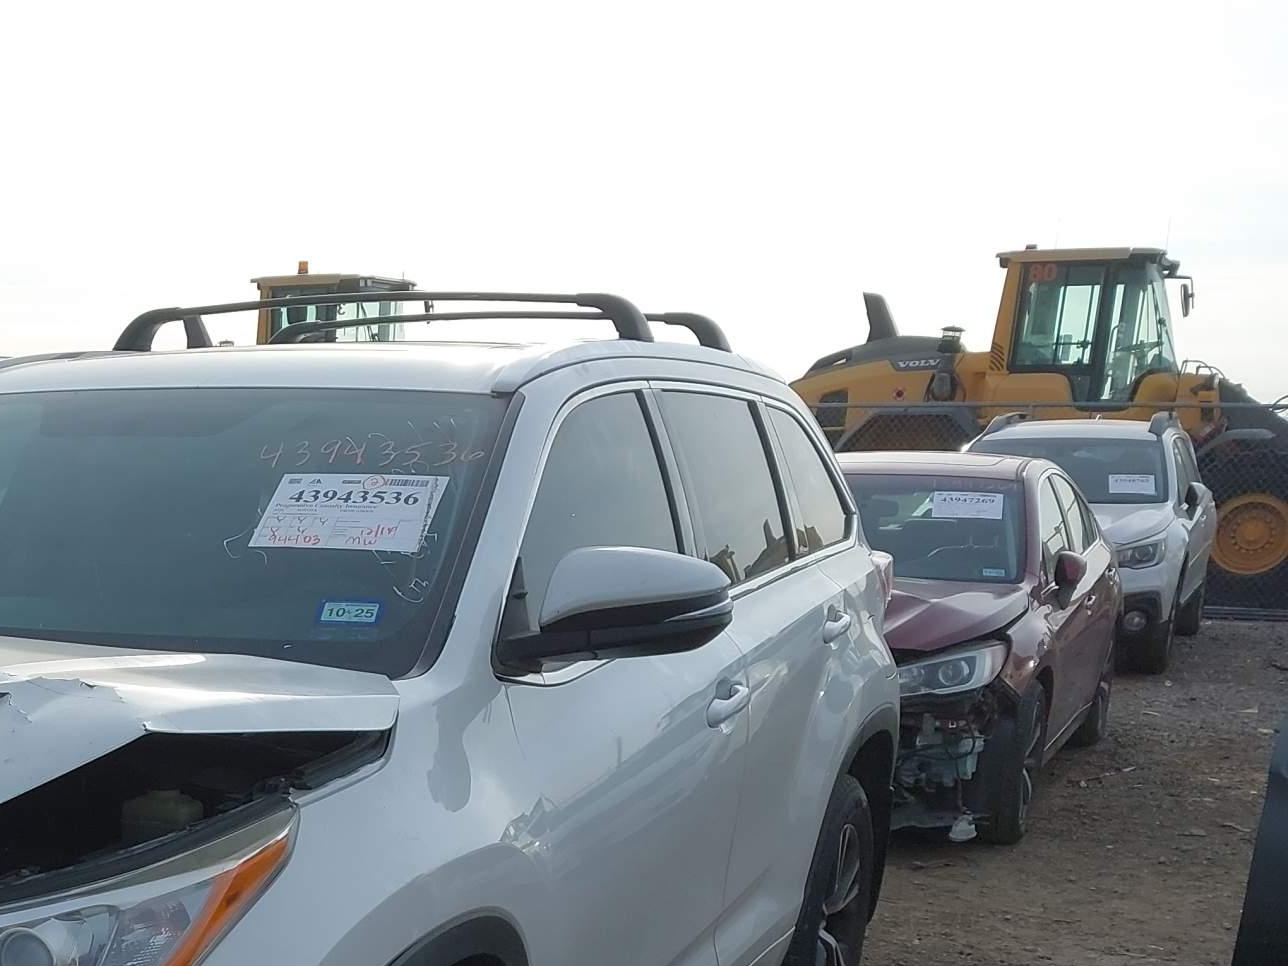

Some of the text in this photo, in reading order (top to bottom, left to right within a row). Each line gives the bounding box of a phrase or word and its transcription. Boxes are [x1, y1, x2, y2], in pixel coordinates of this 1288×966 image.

[896, 359, 941, 368] VOLV
[289, 489, 420, 505] 43943536
[327, 607, 375, 618] 10 25
